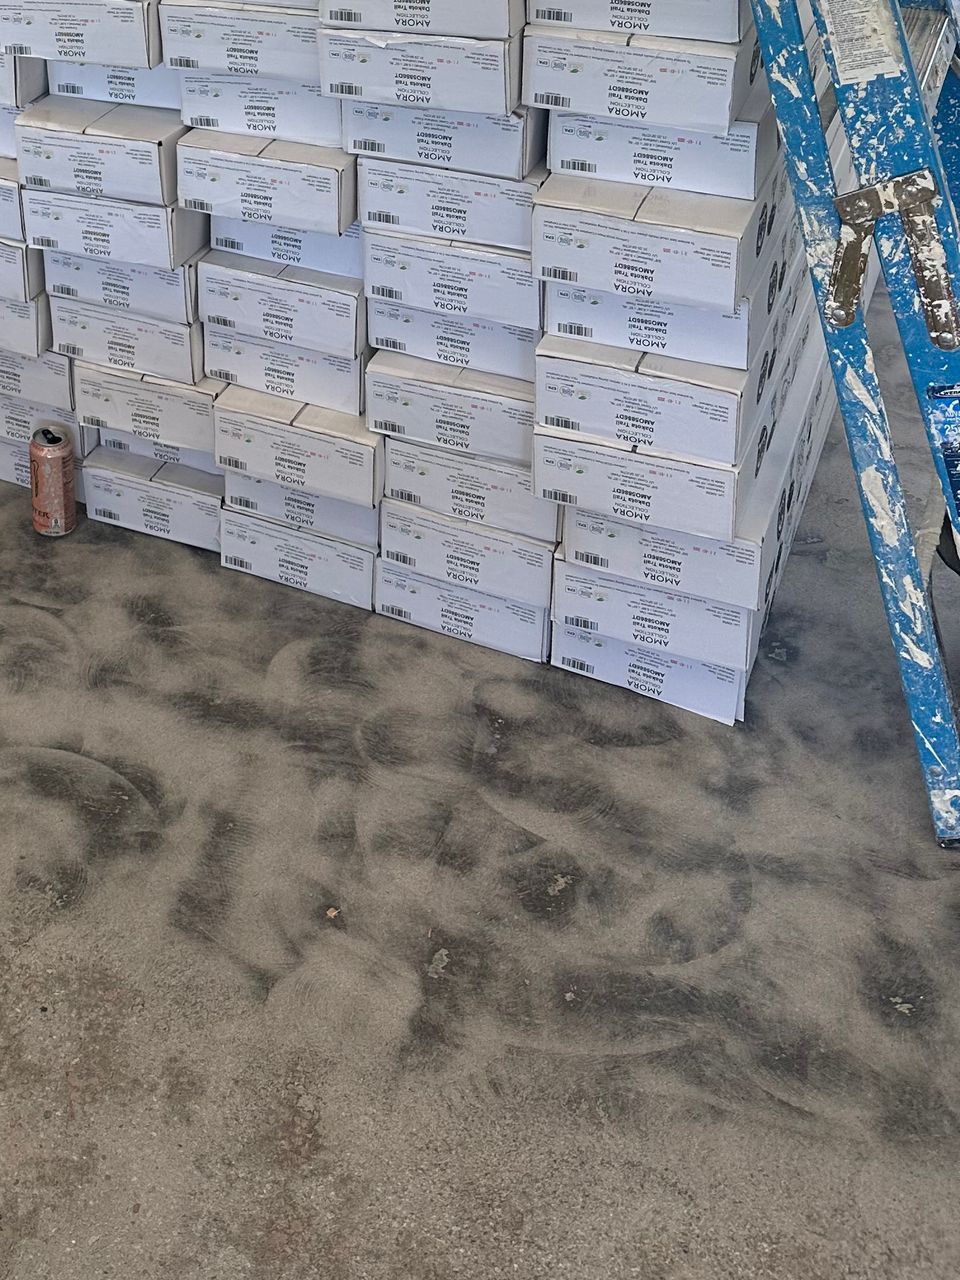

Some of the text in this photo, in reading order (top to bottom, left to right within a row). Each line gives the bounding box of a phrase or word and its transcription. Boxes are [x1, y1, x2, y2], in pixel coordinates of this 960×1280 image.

[626, 7, 651, 15] Dakota
[394, 18, 431, 27] AMORA
[612, 14, 648, 22] COLLECTION
[610, 19, 650, 30] AMORA
[108, 91, 136, 100] AMORA
[608, 92, 648, 103] Dakota Trail
[610, 101, 645, 110] COLLECTION
[607, 106, 647, 119] AMORA
[246, 123, 276, 131] AMORA
[417, 151, 452, 162] AMORA
[633, 171, 672, 183] AMORA
[241, 210, 272, 221] AMORA
[83, 246, 111, 256] AMORA
[433, 288, 468, 299] Dakota Trail
[433, 300, 468, 313] AMORA
[435, 296, 466, 305] COLLECTION
[644, 326, 667, 334] Dakota
[628, 336, 667, 349] AMORA
[631, 332, 665, 341] COLLECTION
[108, 356, 135, 368] AMORA
[265, 383, 294, 395] AMORA
[615, 420, 654, 433] Dakota Trail
[6, 429, 31, 441] AMORA
[615, 432, 654, 446] AMORA
[618, 428, 652, 439] COLLECTION
[275, 473, 306, 486] AMORA
[465, 498, 485, 507] Dakota
[612, 494, 651, 507] Dakota Trail
[451, 506, 485, 520] AMORA
[453, 502, 483, 513] COLLECTION
[612, 506, 650, 521] AMORA
[615, 502, 648, 513] COLLECTION
[144, 522, 170, 534] AMORA
[278, 574, 308, 588] AMORA
[441, 624, 473, 639] AMORA
[632, 621, 670, 634] Dakota Trail
[632, 633, 669, 647] AMORA
[635, 628, 667, 640] COLLECTION
[627, 680, 663, 696] AMORA
